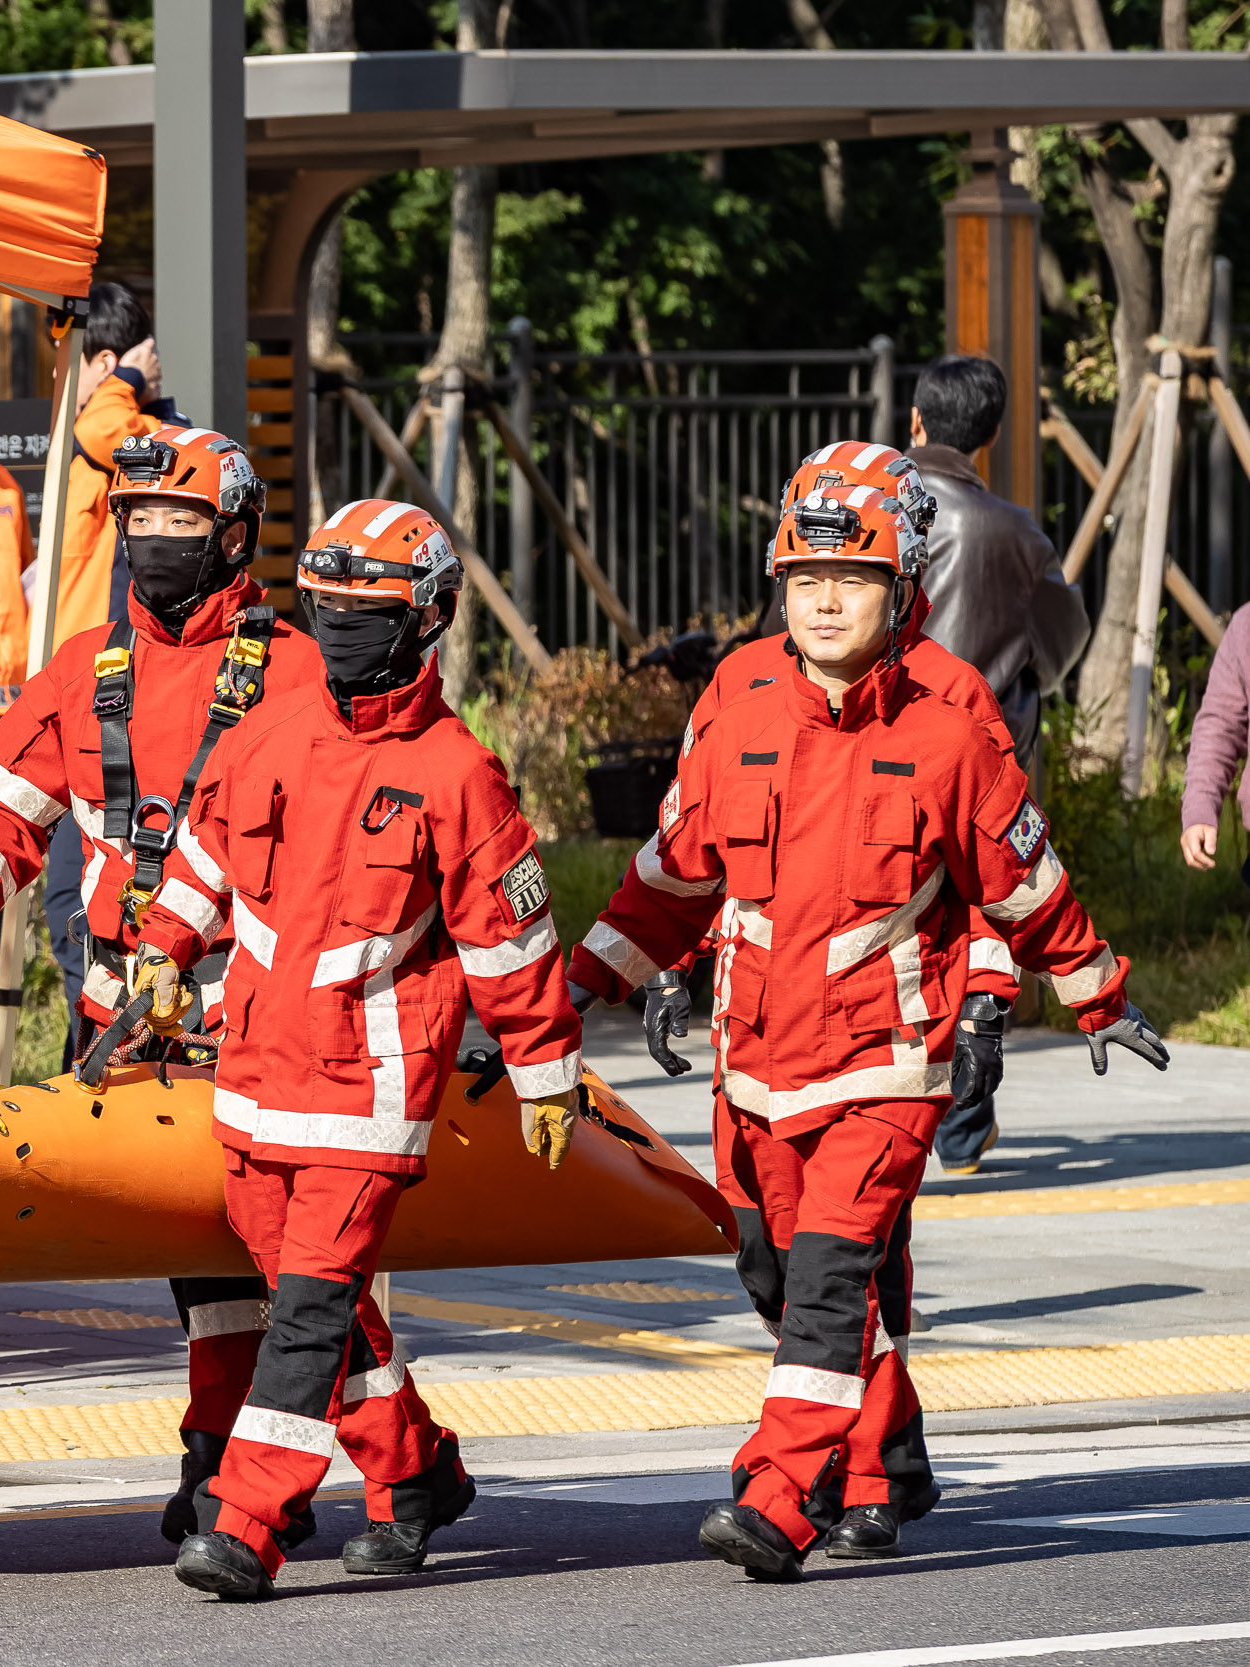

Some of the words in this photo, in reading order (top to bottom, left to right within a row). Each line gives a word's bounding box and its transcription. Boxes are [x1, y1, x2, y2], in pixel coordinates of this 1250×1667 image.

[222, 456, 236, 472] 119
[900, 477, 911, 496] 119
[414, 543, 429, 565] 119
[363, 562, 385, 573] PETZL
[1021, 822, 1046, 860] KOREA
[504, 854, 540, 895] RESCUE
[513, 874, 548, 917] FIRE
